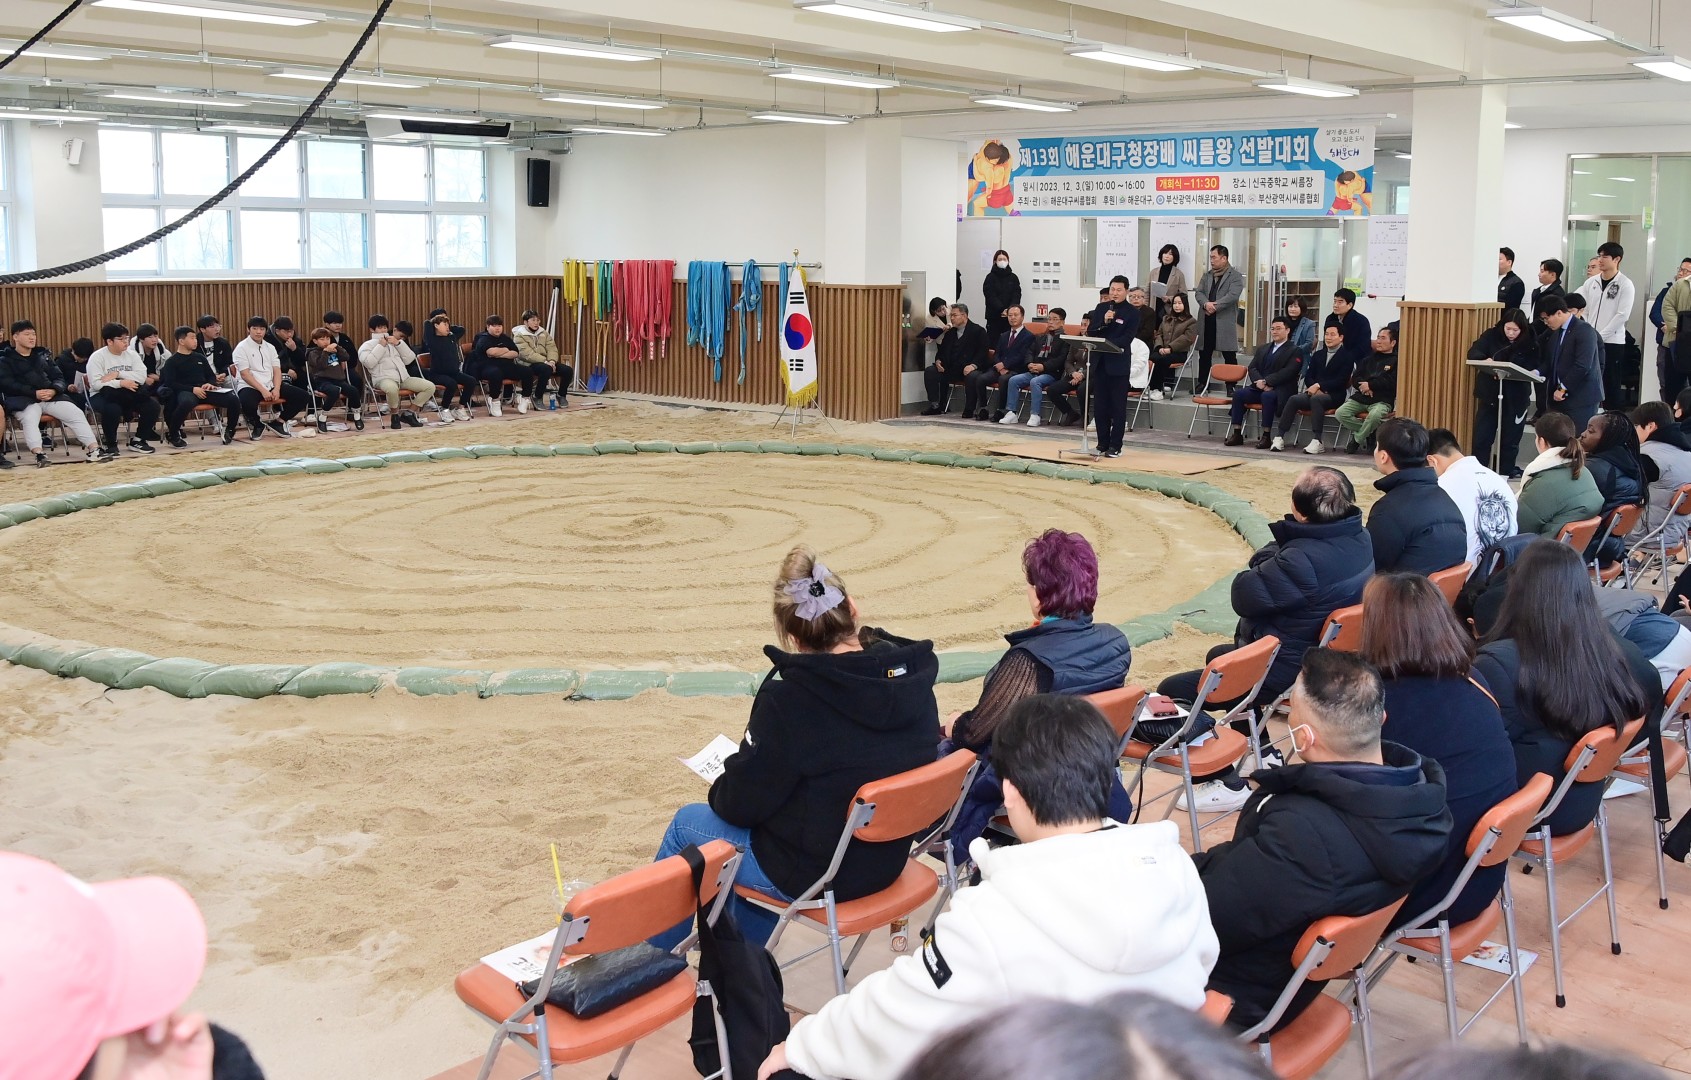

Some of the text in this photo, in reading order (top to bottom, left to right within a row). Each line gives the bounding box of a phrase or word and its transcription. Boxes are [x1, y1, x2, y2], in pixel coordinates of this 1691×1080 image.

[1020, 135, 1310, 168] 제13회 해운대구청장배 씨름왕 선발대회
[1096, 180, 1116, 190] 10:00
[1160, 179, 1182, 189] 개회식
[1253, 177, 1288, 188] 신곡중학교
[1291, 176, 1314, 188] 씨름장
[1051, 196, 1097, 206] 해운대구씨름협회
[1258, 193, 1320, 204] 부산광역시씨름협회
